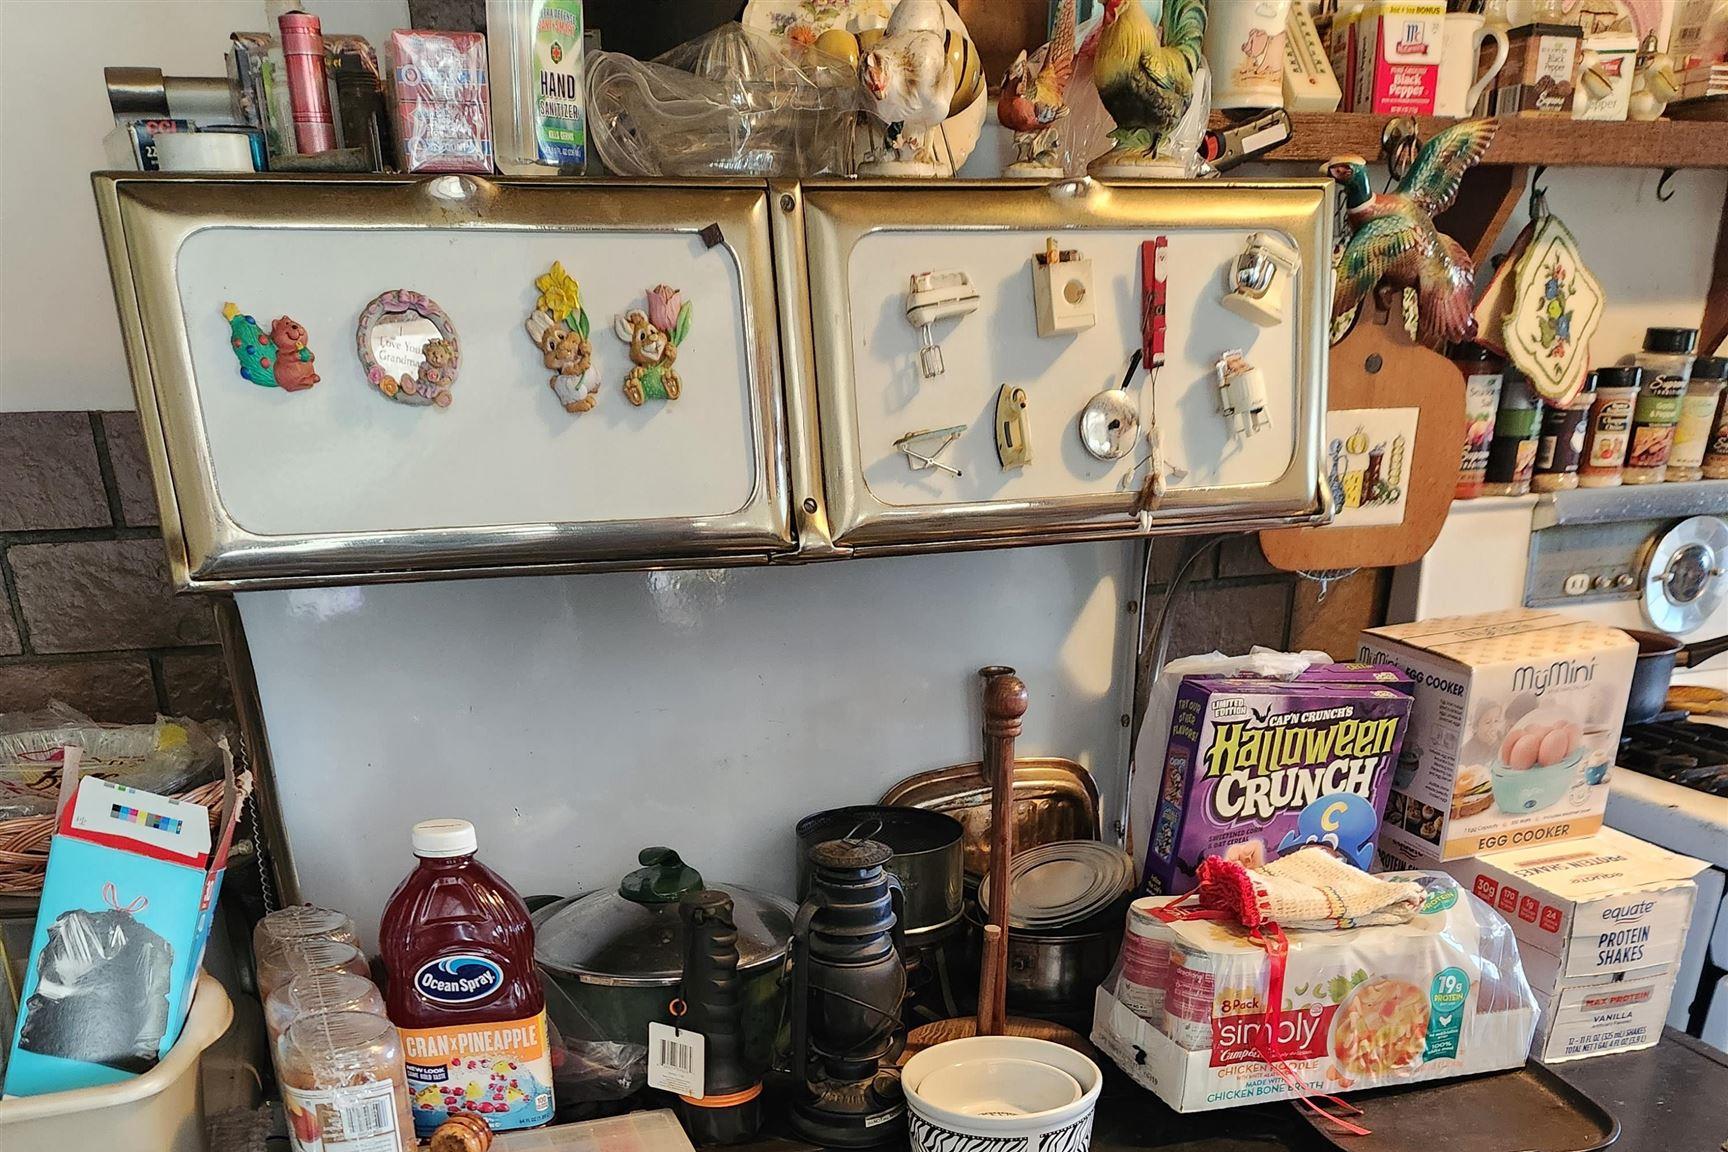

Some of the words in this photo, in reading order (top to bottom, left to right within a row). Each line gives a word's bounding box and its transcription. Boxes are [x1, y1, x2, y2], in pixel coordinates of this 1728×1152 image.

[540, 71, 576, 100] HAND
[1394, 72, 1422, 86] Black
[1388, 84, 1424, 98] Pepper
[540, 100, 579, 120] SANITIZER
[380, 336, 402, 350] Love
[404, 342, 423, 354] You
[1512, 657, 1596, 696] MyMini
[1426, 676, 1464, 696] COOKER
[1212, 698, 1244, 710] LIMITED
[1216, 707, 1246, 718] EDITION
[1268, 713, 1300, 727] CAP'N
[1301, 706, 1354, 724] CRUNCH'S
[1206, 717, 1400, 777] Halloween
[1215, 757, 1380, 819] CRUNCH
[1321, 801, 1348, 832] C
[1208, 829, 1244, 842] SWEETENED
[1246, 826, 1264, 836] CORN
[1213, 840, 1226, 849] OAT
[1226, 836, 1250, 847] CEREAL
[1478, 835, 1508, 850] EGG
[1512, 824, 1570, 844] COOKER
[1570, 855, 1627, 868] PROTEIN
[1478, 879, 1495, 897] 30g
[1602, 900, 1654, 920] equate
[1598, 926, 1650, 948] PROTEIN
[1597, 944, 1645, 966] SHAKES
[422, 973, 460, 992] Ocean
[460, 970, 492, 992] Spray
[1438, 976, 1462, 994] 19g
[1222, 1000, 1232, 1012] 8
[1232, 998, 1258, 1010] Pack
[1434, 992, 1464, 1002] PROTEIN
[1586, 996, 1608, 1008] MAX
[1609, 990, 1650, 1004] PROTEIN
[1594, 1012, 1632, 1022] VANILLA
[1626, 1026, 1647, 1036] SHAKES
[406, 1035, 450, 1058] CRAN
[458, 1025, 538, 1054] PINEAPPLE
[1566, 1044, 1580, 1054] TOTAL
[1582, 1043, 1592, 1052] NET
[1598, 1040, 1608, 1049] GAL
[1218, 1062, 1267, 1078] CHICKEN
[1207, 1087, 1254, 1102] CHICKEN
[1256, 1084, 1284, 1096] BONE
